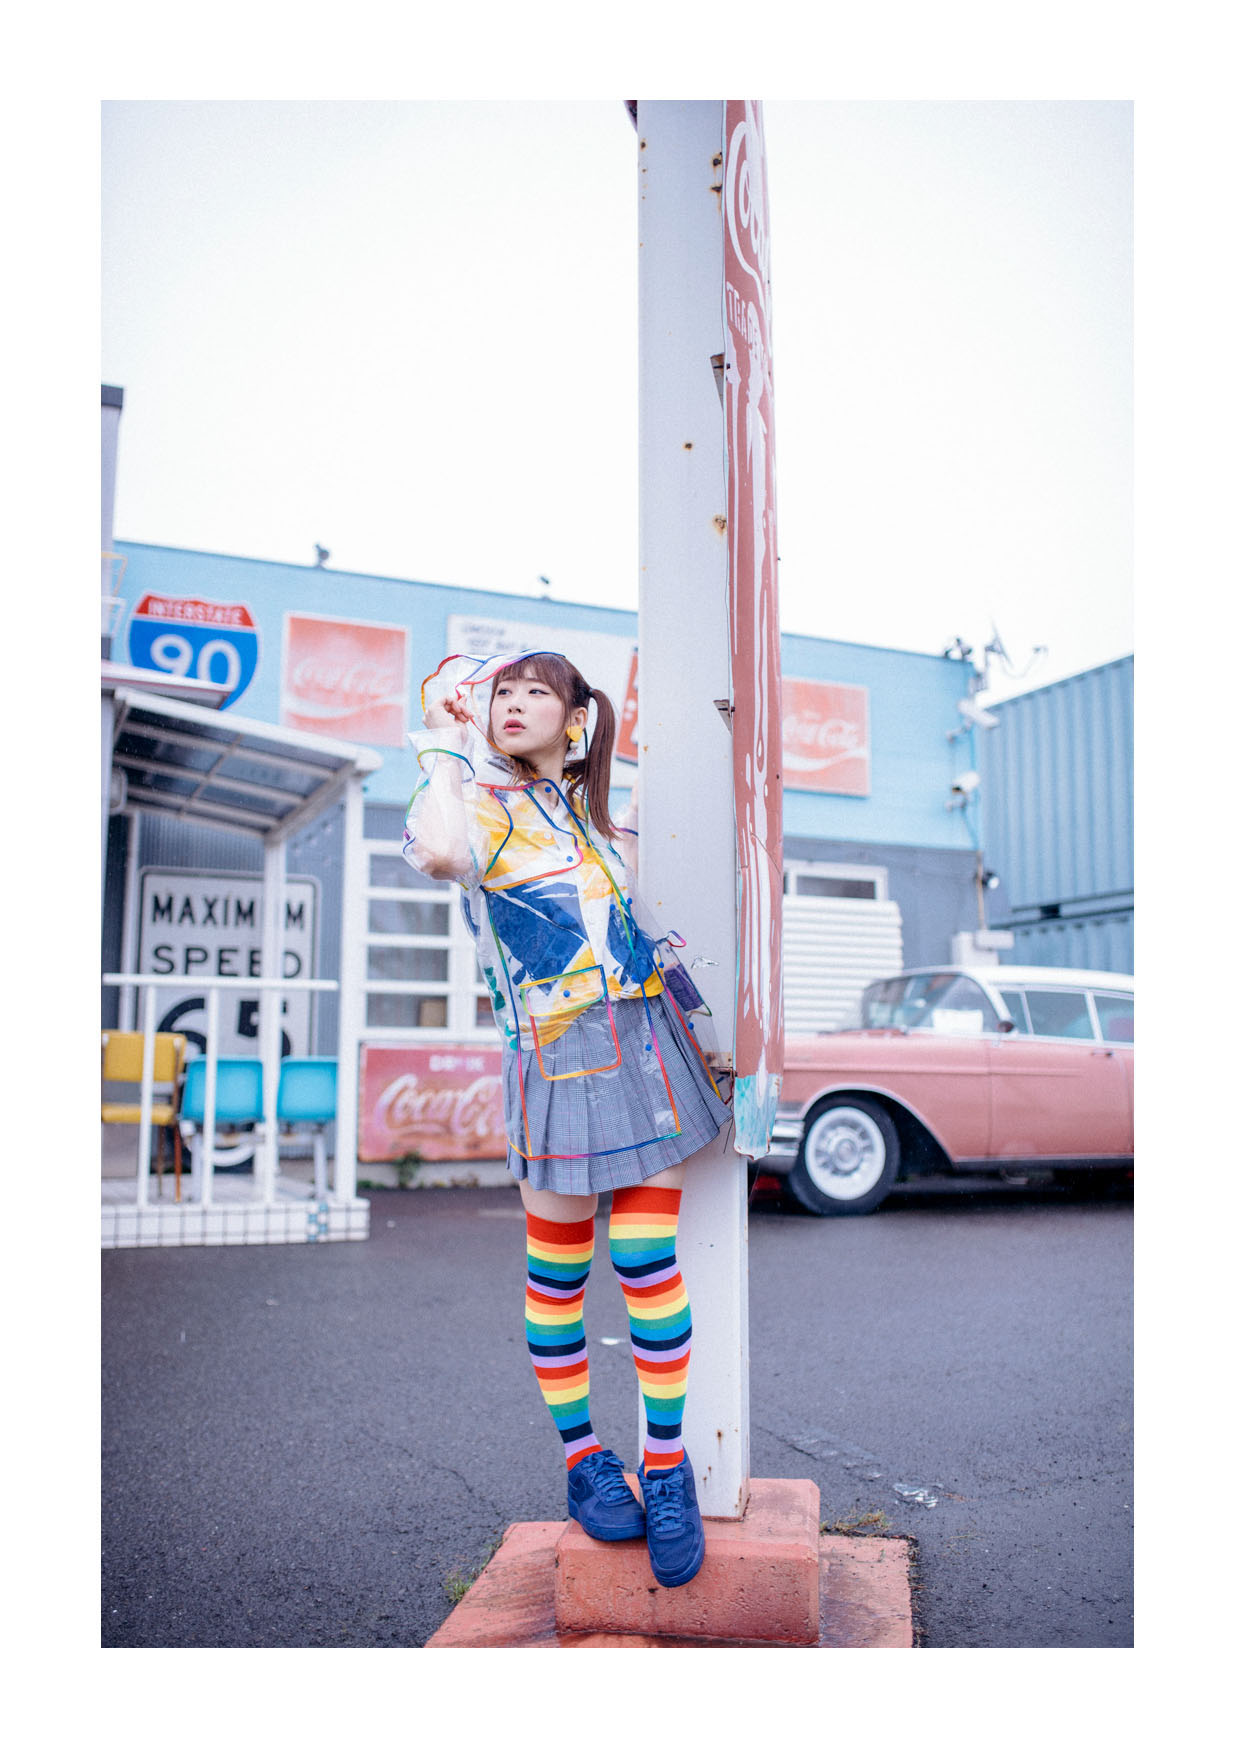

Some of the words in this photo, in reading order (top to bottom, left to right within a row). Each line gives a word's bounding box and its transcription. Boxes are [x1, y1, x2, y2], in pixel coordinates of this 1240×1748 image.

[148, 600, 242, 625] INTERSTATE
[150, 633, 241, 690] 90
[152, 894, 304, 930] MAXIMM
